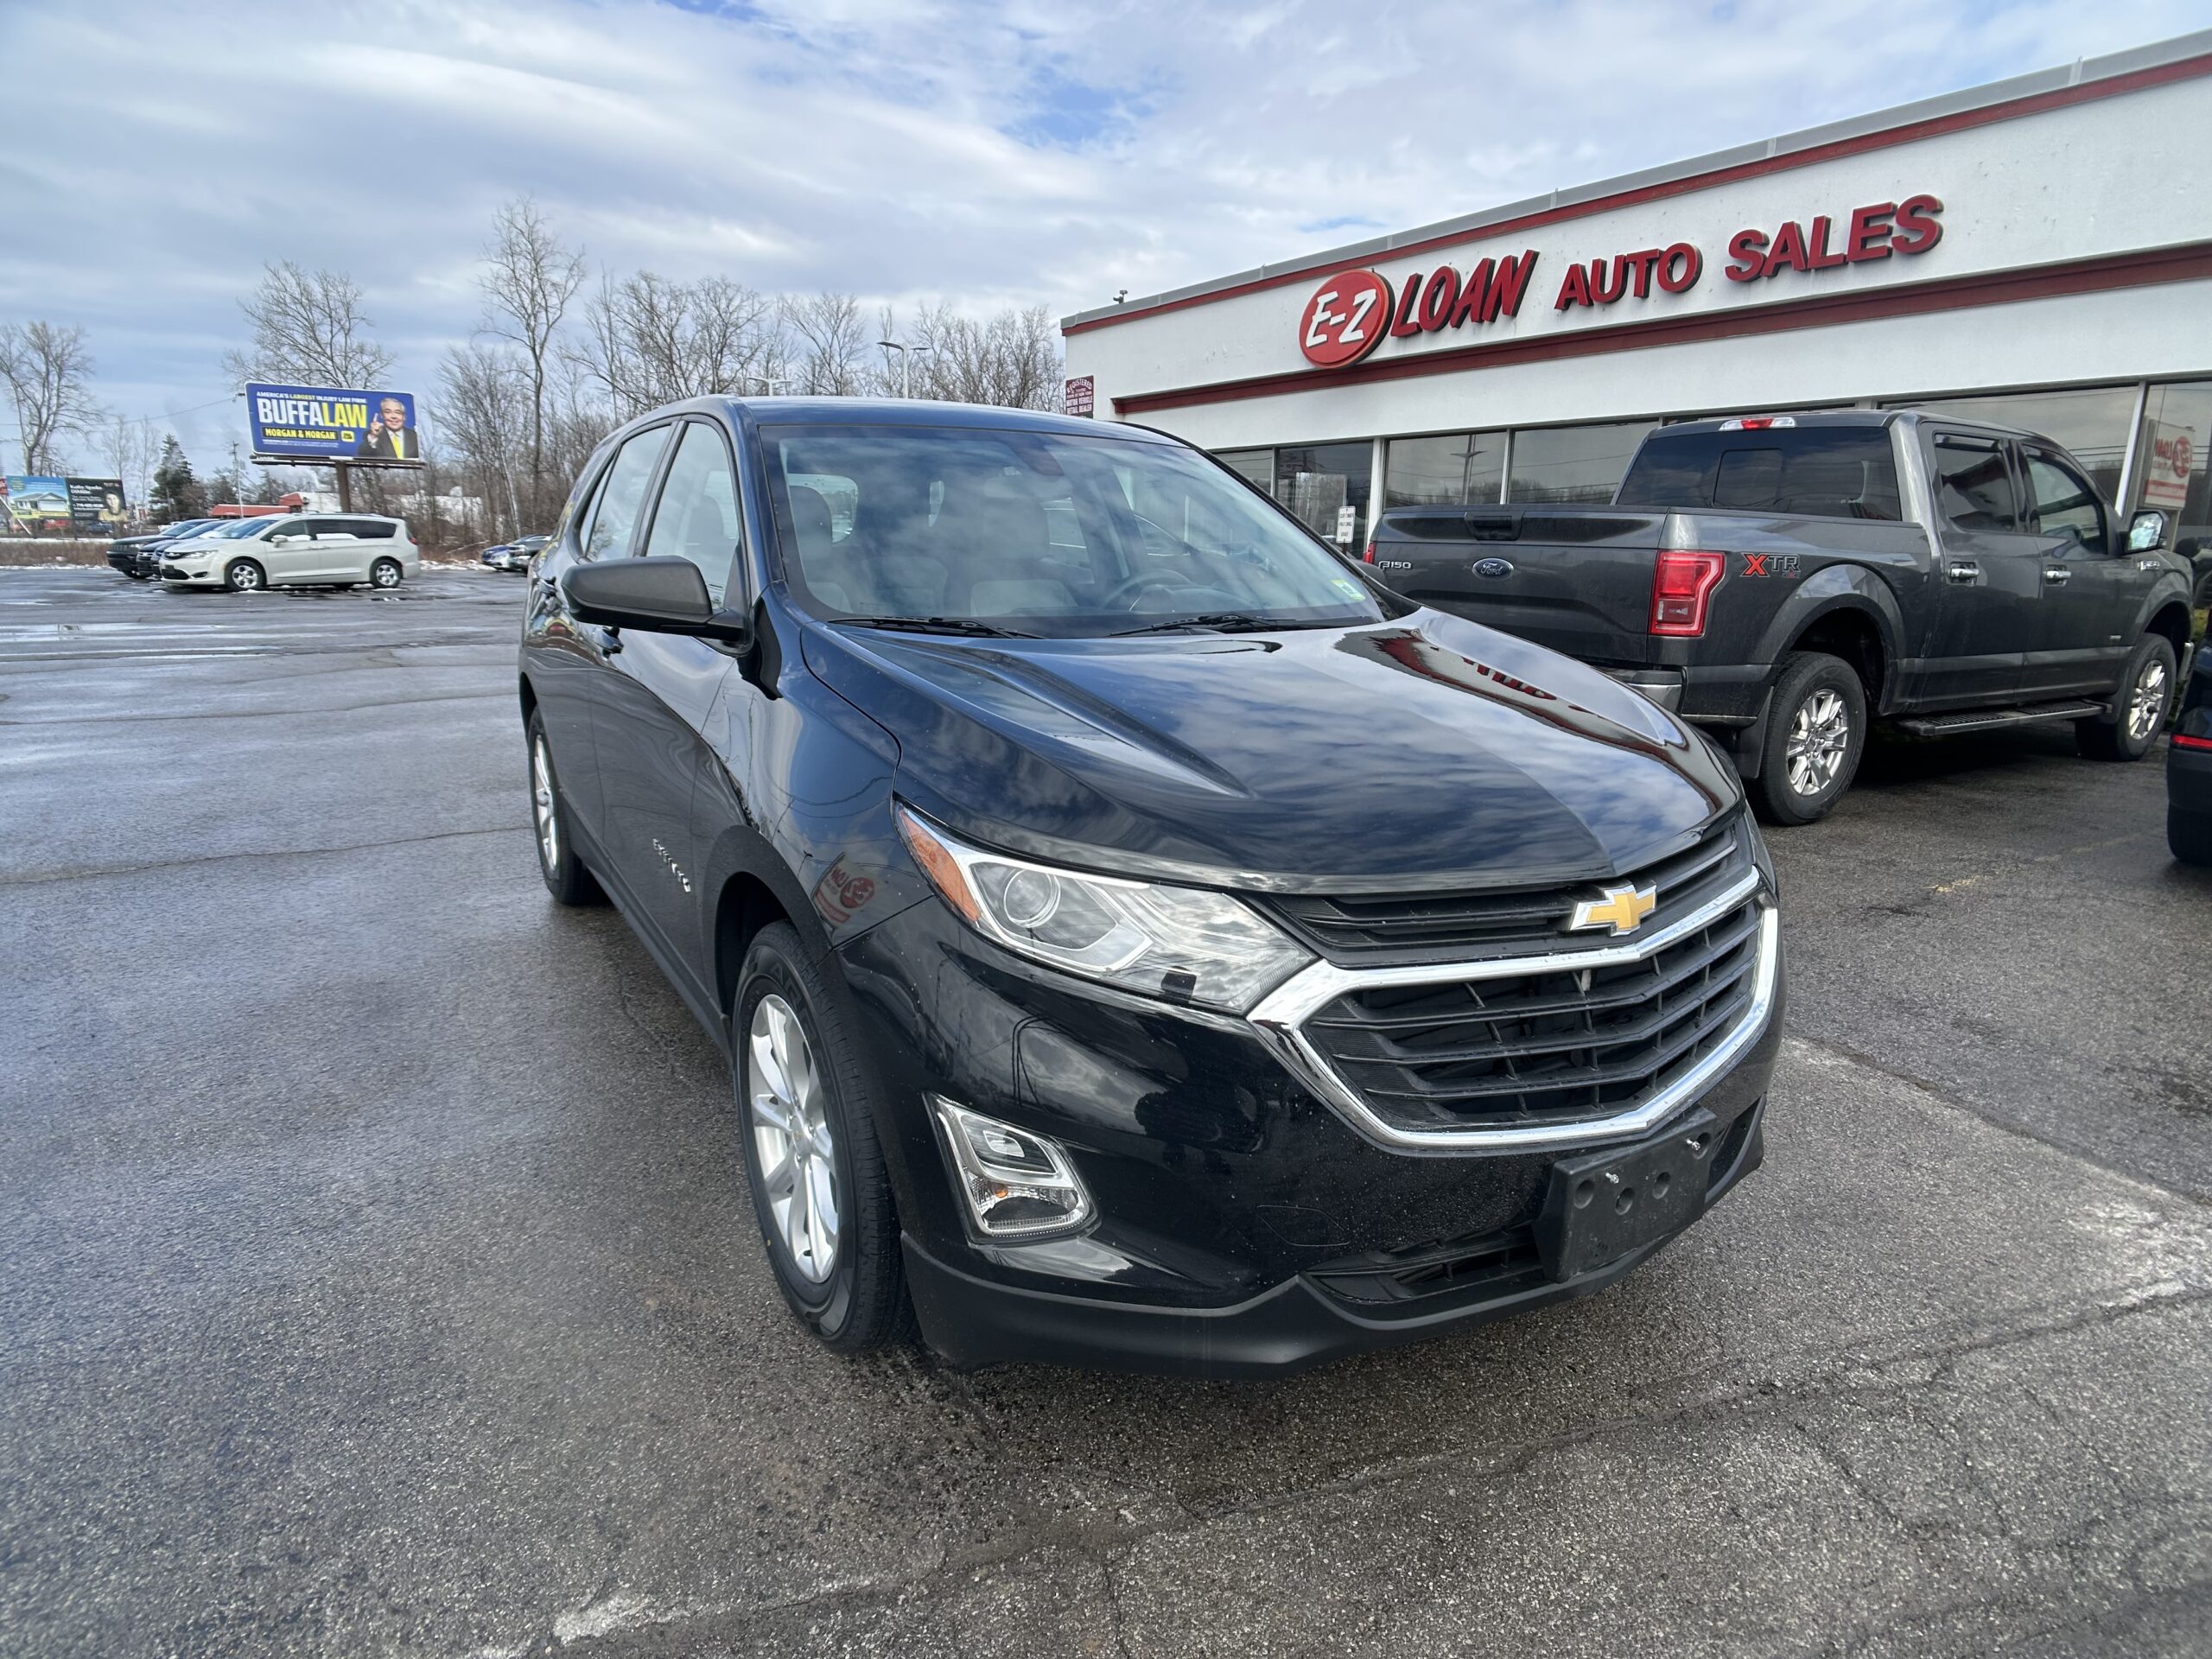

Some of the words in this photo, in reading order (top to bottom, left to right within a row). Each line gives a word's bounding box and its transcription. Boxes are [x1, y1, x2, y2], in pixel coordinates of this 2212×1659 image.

[1390, 249, 1540, 338] LOAN
[1554, 242, 1704, 310] AUTO
[1725, 194, 1945, 283] SALES
[257, 398, 367, 429] BUFFALAW
[264, 428, 297, 438] MORGAN
[304, 431, 336, 440] MORGAN
[1480, 563, 1503, 575] Ford
[1739, 552, 1801, 578] XTR
